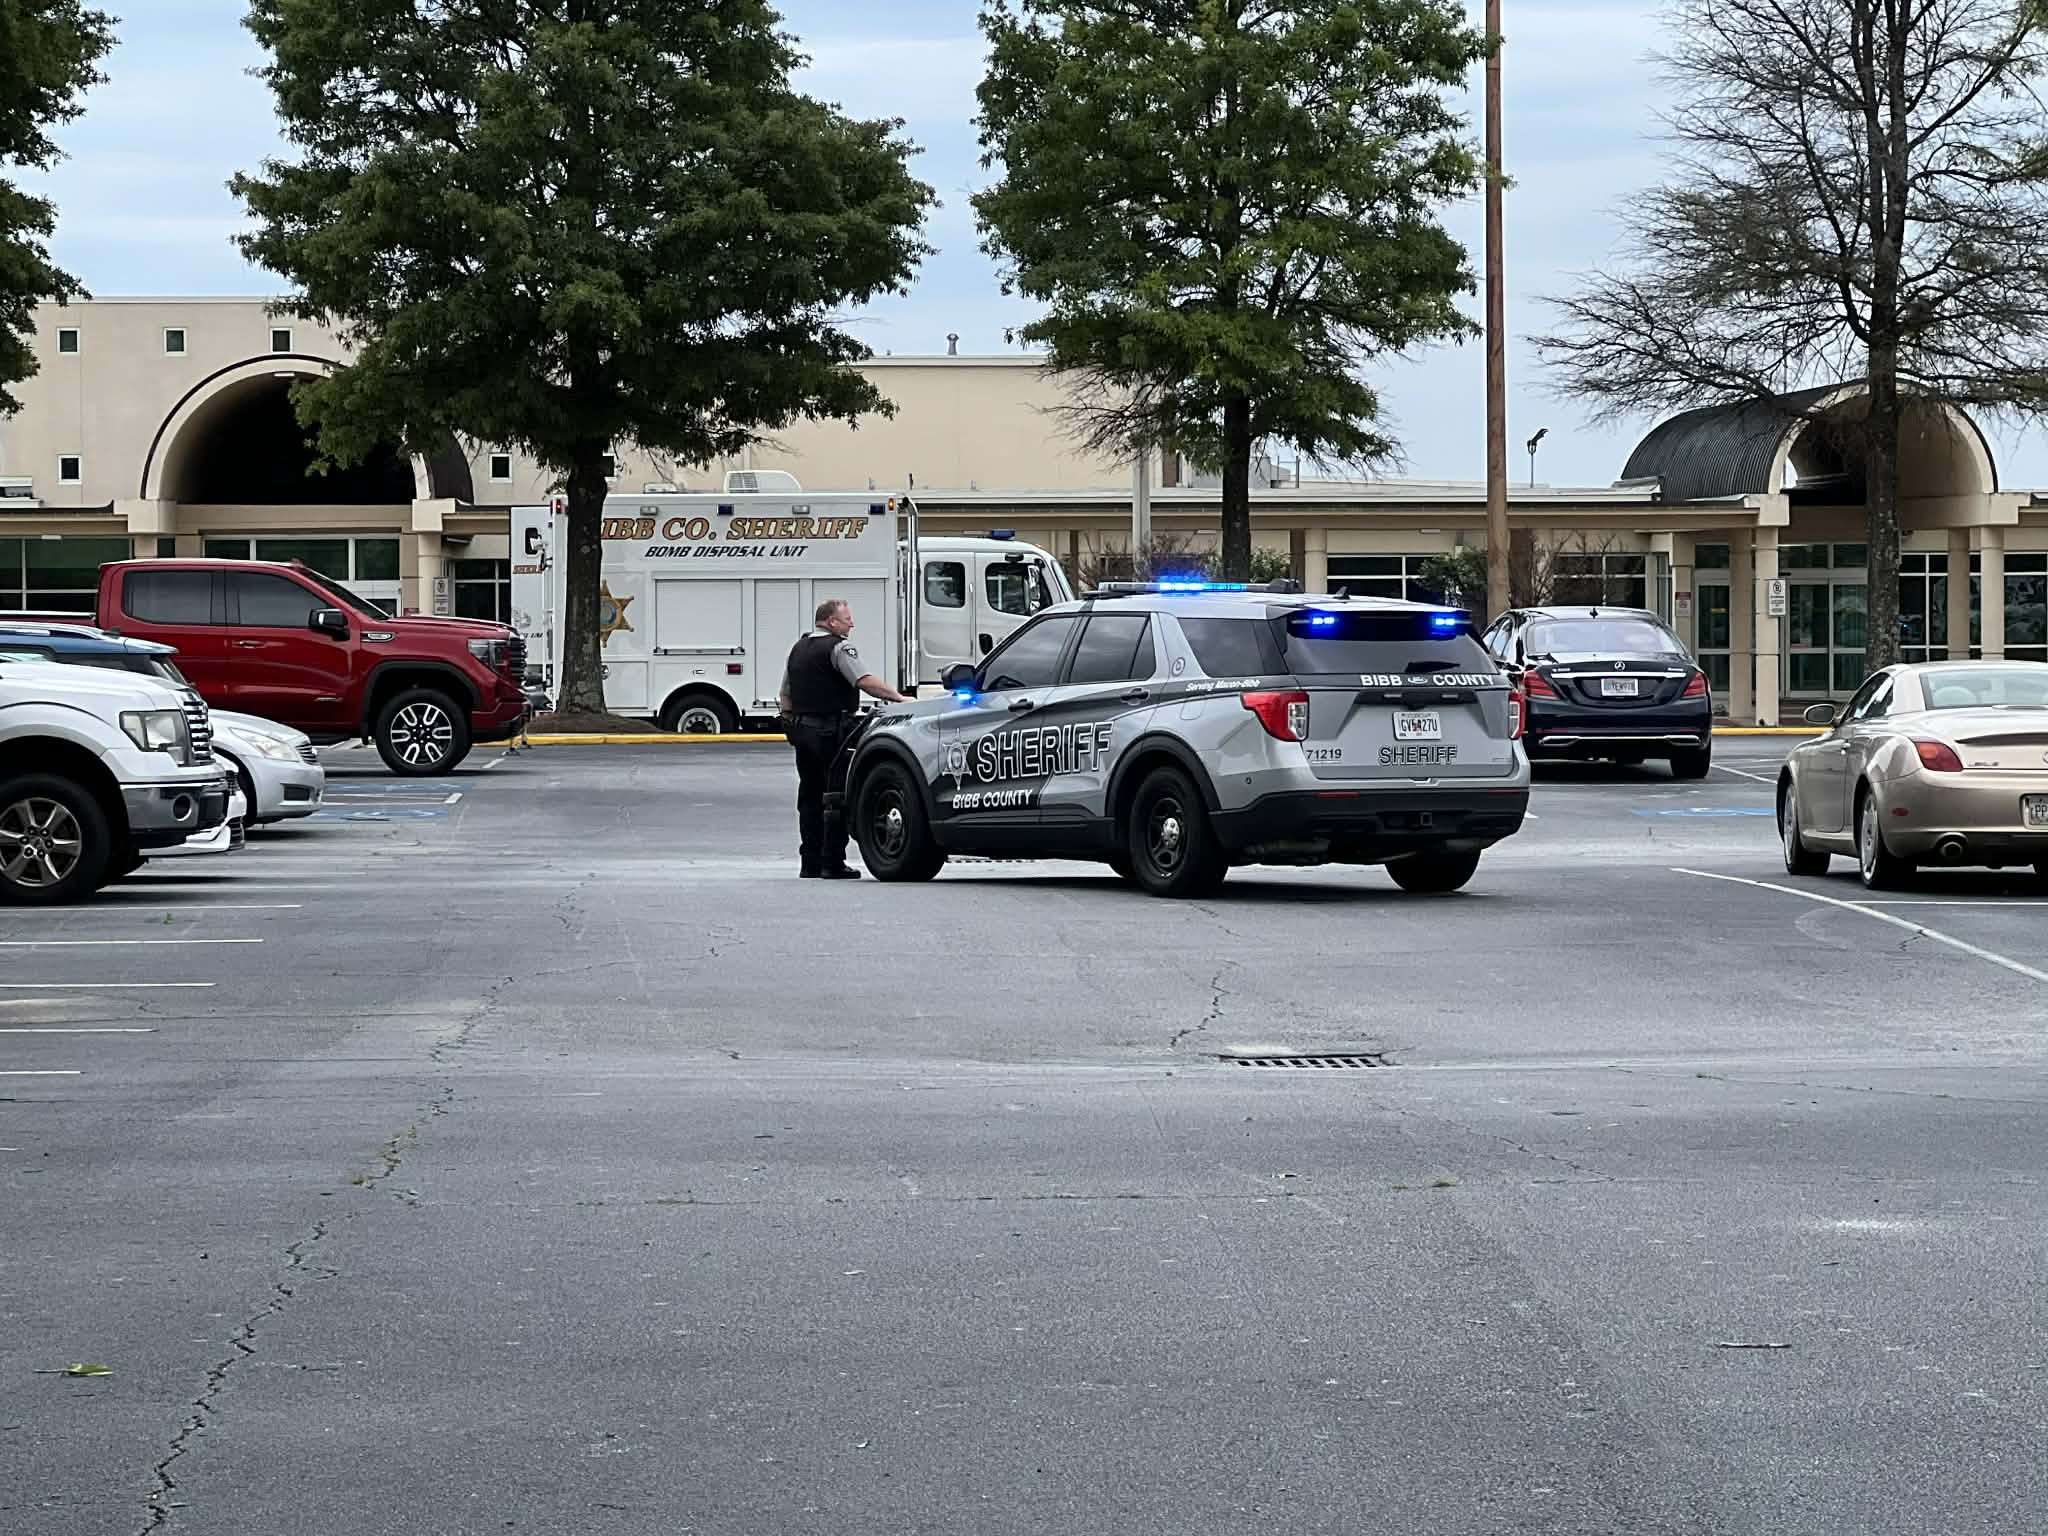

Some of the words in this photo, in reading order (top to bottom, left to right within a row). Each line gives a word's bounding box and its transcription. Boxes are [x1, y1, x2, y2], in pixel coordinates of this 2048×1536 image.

[600, 517, 656, 540] IBB
[662, 517, 717, 540] CO.
[726, 516, 869, 540] SHERIFF
[644, 545, 692, 558] BOMB
[692, 545, 766, 558] DISPOSAL
[769, 545, 809, 557] UNIT
[1360, 674, 1403, 686] BIBB
[1432, 674, 1495, 686] COUNTY
[976, 721, 1114, 783] SHERIFF
[1306, 748, 1342, 760] 71219
[1378, 745, 1458, 767] SHERIFF
[952, 793, 980, 809] BIBB
[983, 788, 1033, 807] COUNTY
